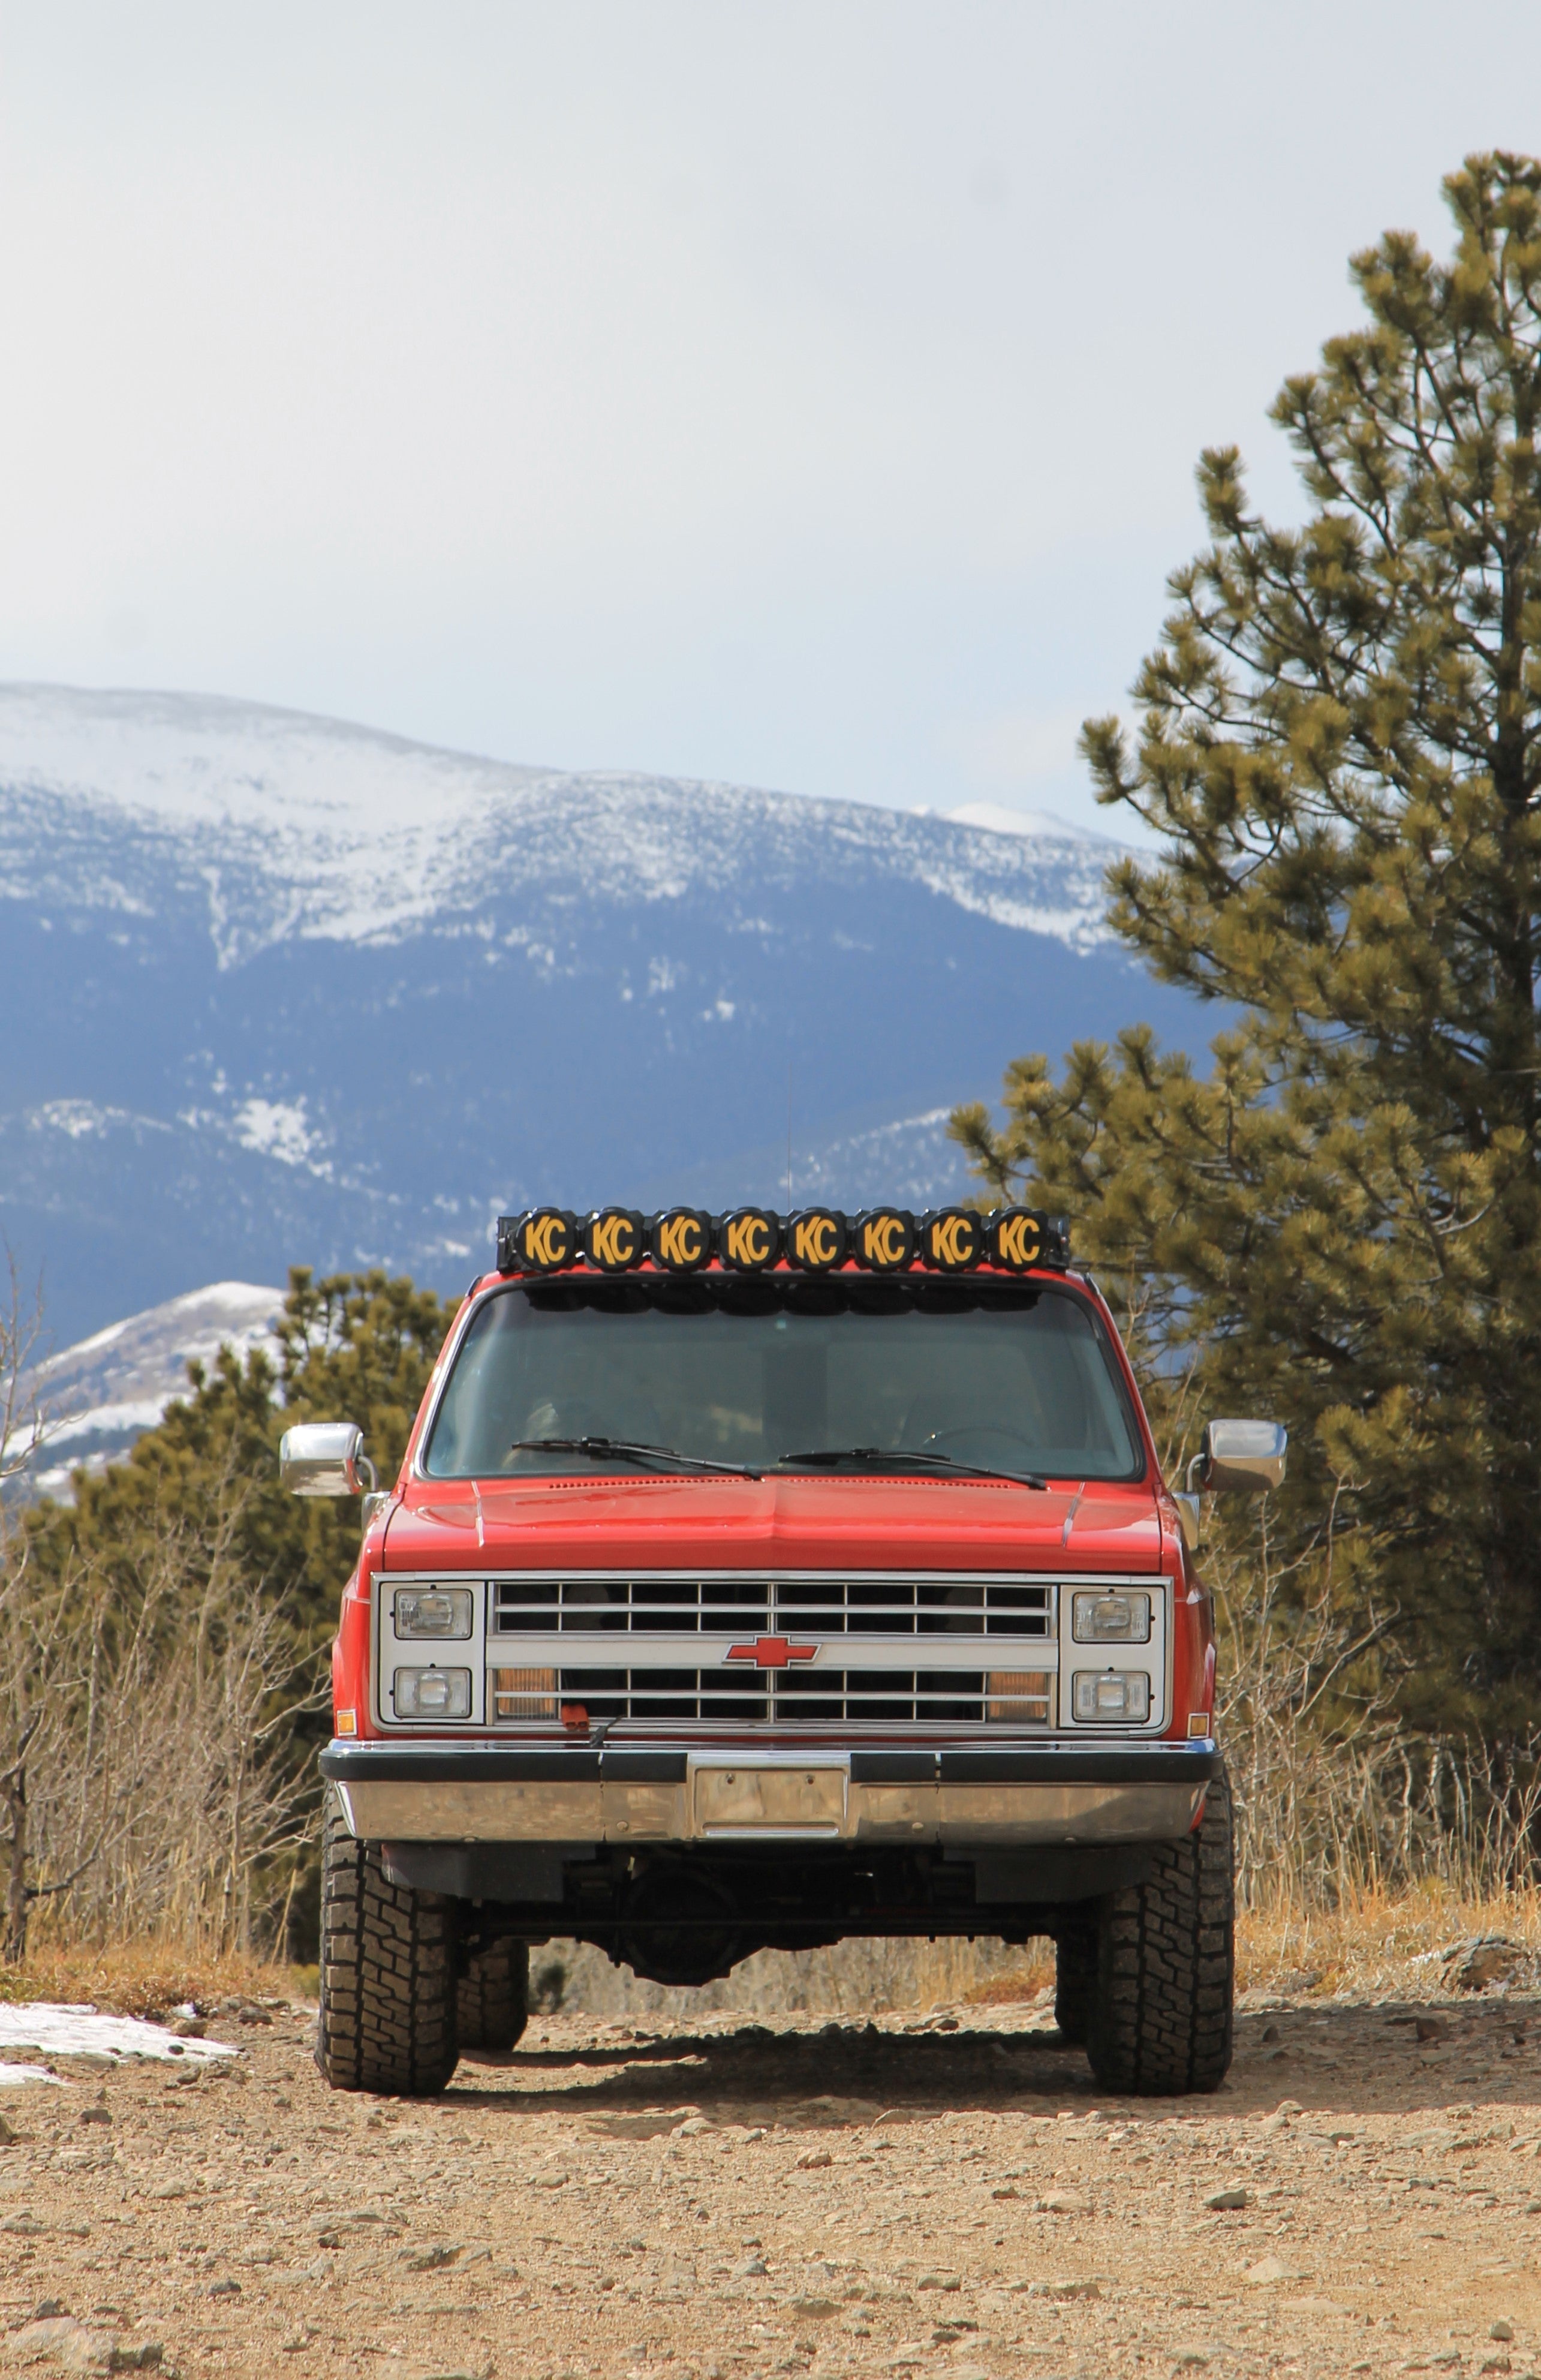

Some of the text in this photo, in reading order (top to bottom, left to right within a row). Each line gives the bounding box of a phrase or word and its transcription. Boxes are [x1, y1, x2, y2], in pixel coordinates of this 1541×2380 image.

[525, 1215, 566, 1265] KC
[592, 1215, 633, 1265] KC
[660, 1216, 701, 1264] KC
[727, 1215, 769, 1264] KC
[796, 1216, 837, 1264] KC
[864, 1216, 905, 1264] KC
[932, 1216, 973, 1264] KC
[999, 1215, 1040, 1264] KC
